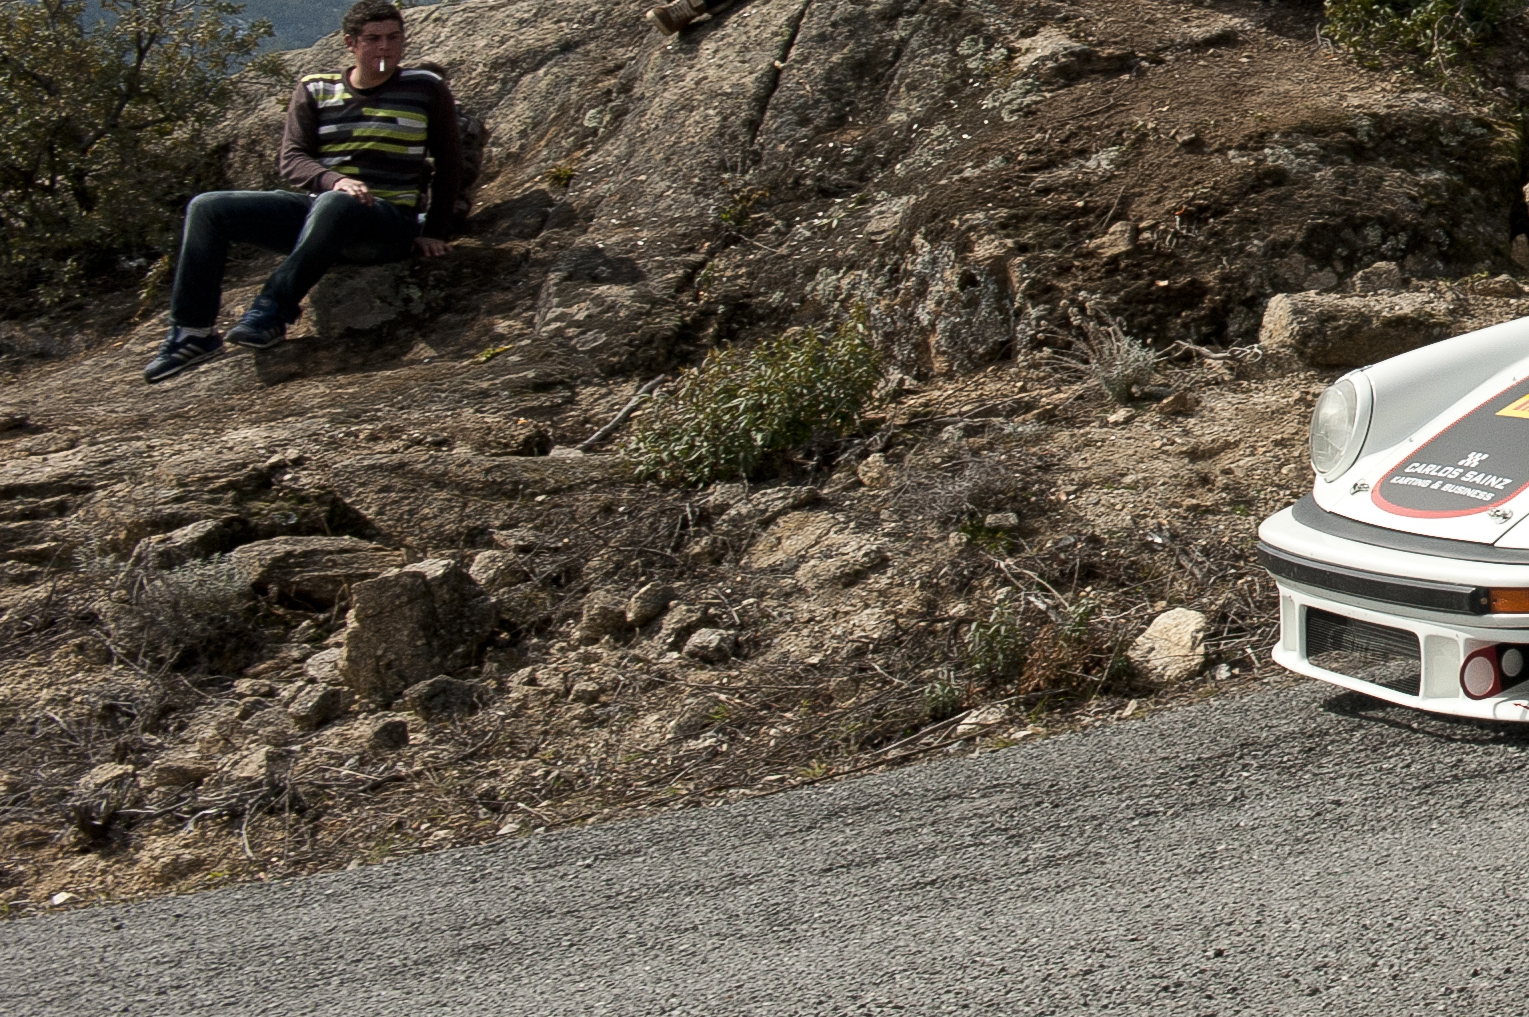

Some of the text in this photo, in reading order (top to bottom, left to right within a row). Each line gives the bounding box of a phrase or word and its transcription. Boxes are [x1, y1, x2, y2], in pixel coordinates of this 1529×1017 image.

[1390, 475, 1495, 501] KARTING & BUSINESS
[1404, 462, 1513, 490] CARLOS SAINZ
